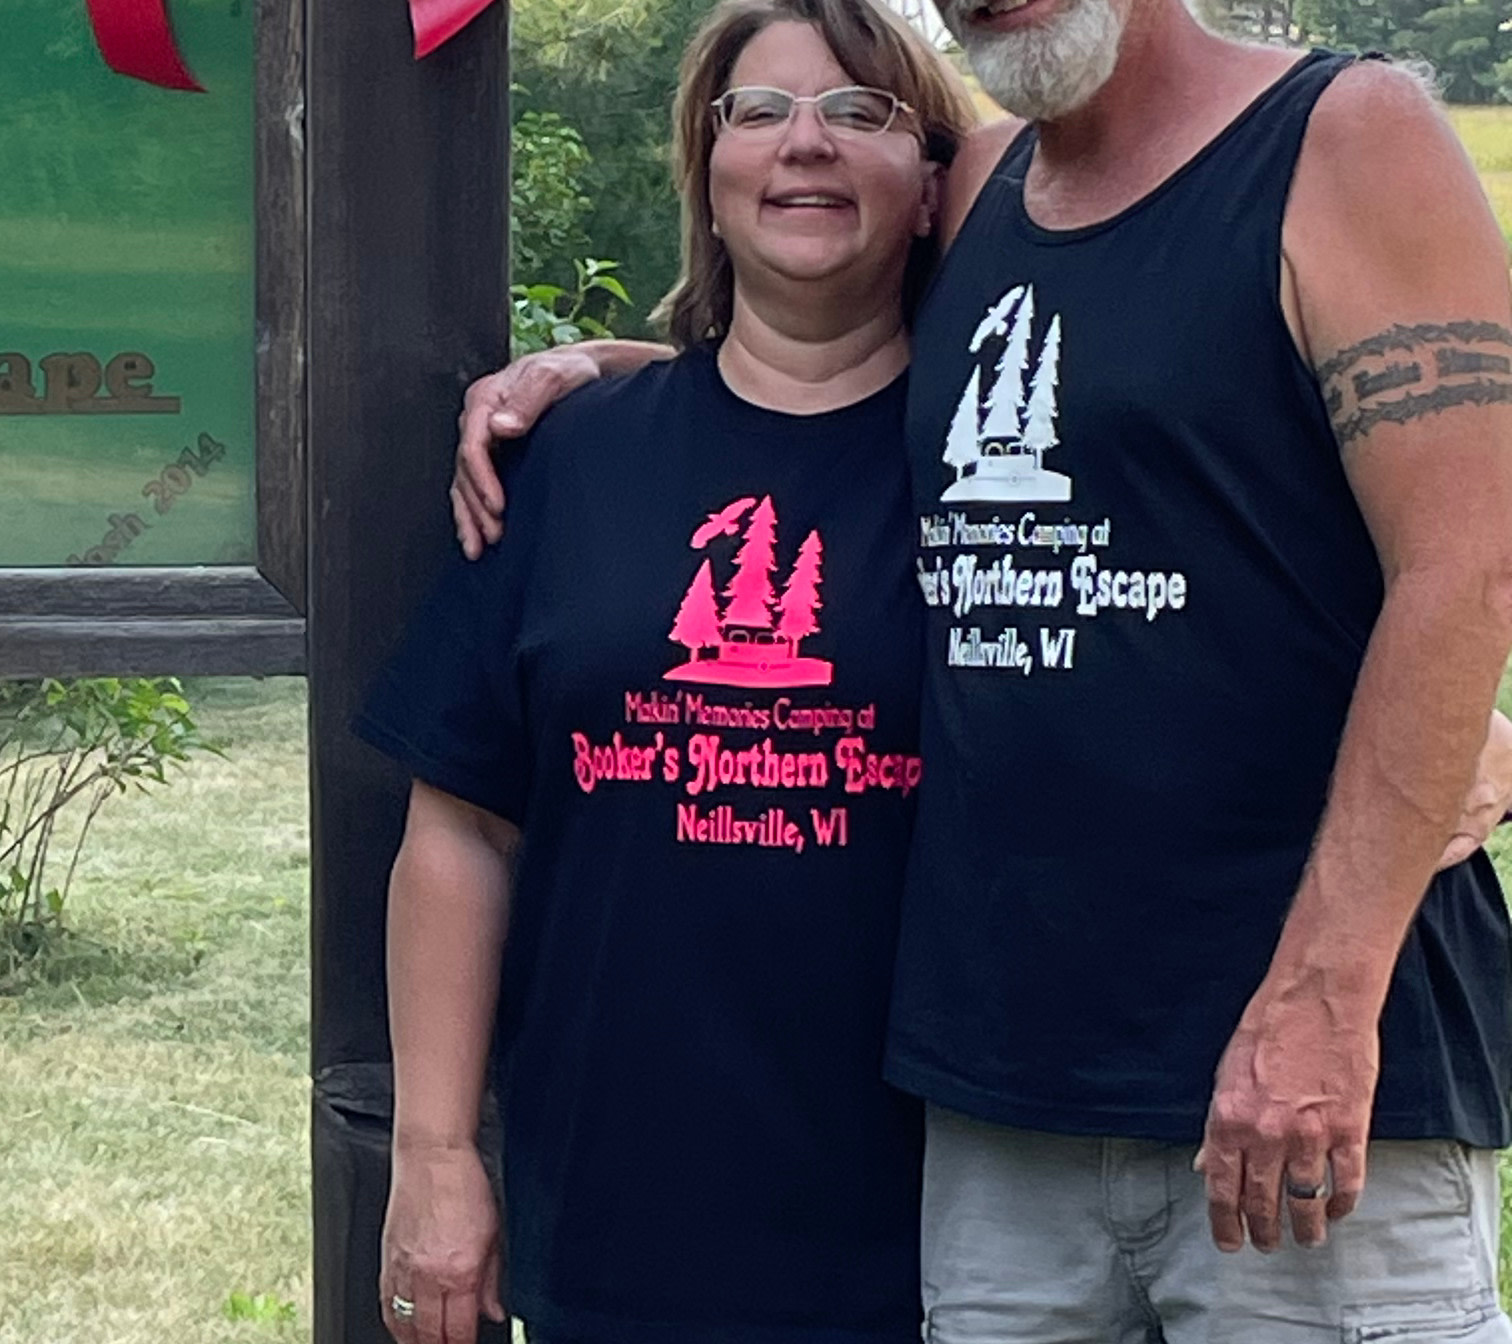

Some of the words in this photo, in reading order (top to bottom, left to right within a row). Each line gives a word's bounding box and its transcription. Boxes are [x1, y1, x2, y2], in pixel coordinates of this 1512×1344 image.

[142, 431, 227, 516] 2014
[1017, 512, 1088, 554] Camping
[1091, 517, 1112, 547] at
[952, 554, 1063, 618] Northern
[1070, 554, 1187, 621] Escape
[947, 627, 1033, 677] Neillsville,
[1039, 627, 1077, 669] WI
[624, 690, 683, 724] Makin'
[684, 692, 770, 730] Memories
[773, 697, 854, 736] Camping
[856, 703, 876, 730] at
[571, 731, 680, 794] Booker's
[686, 733, 829, 796] Northern
[676, 802, 805, 854] Neillsville,
[810, 807, 849, 847] WI
